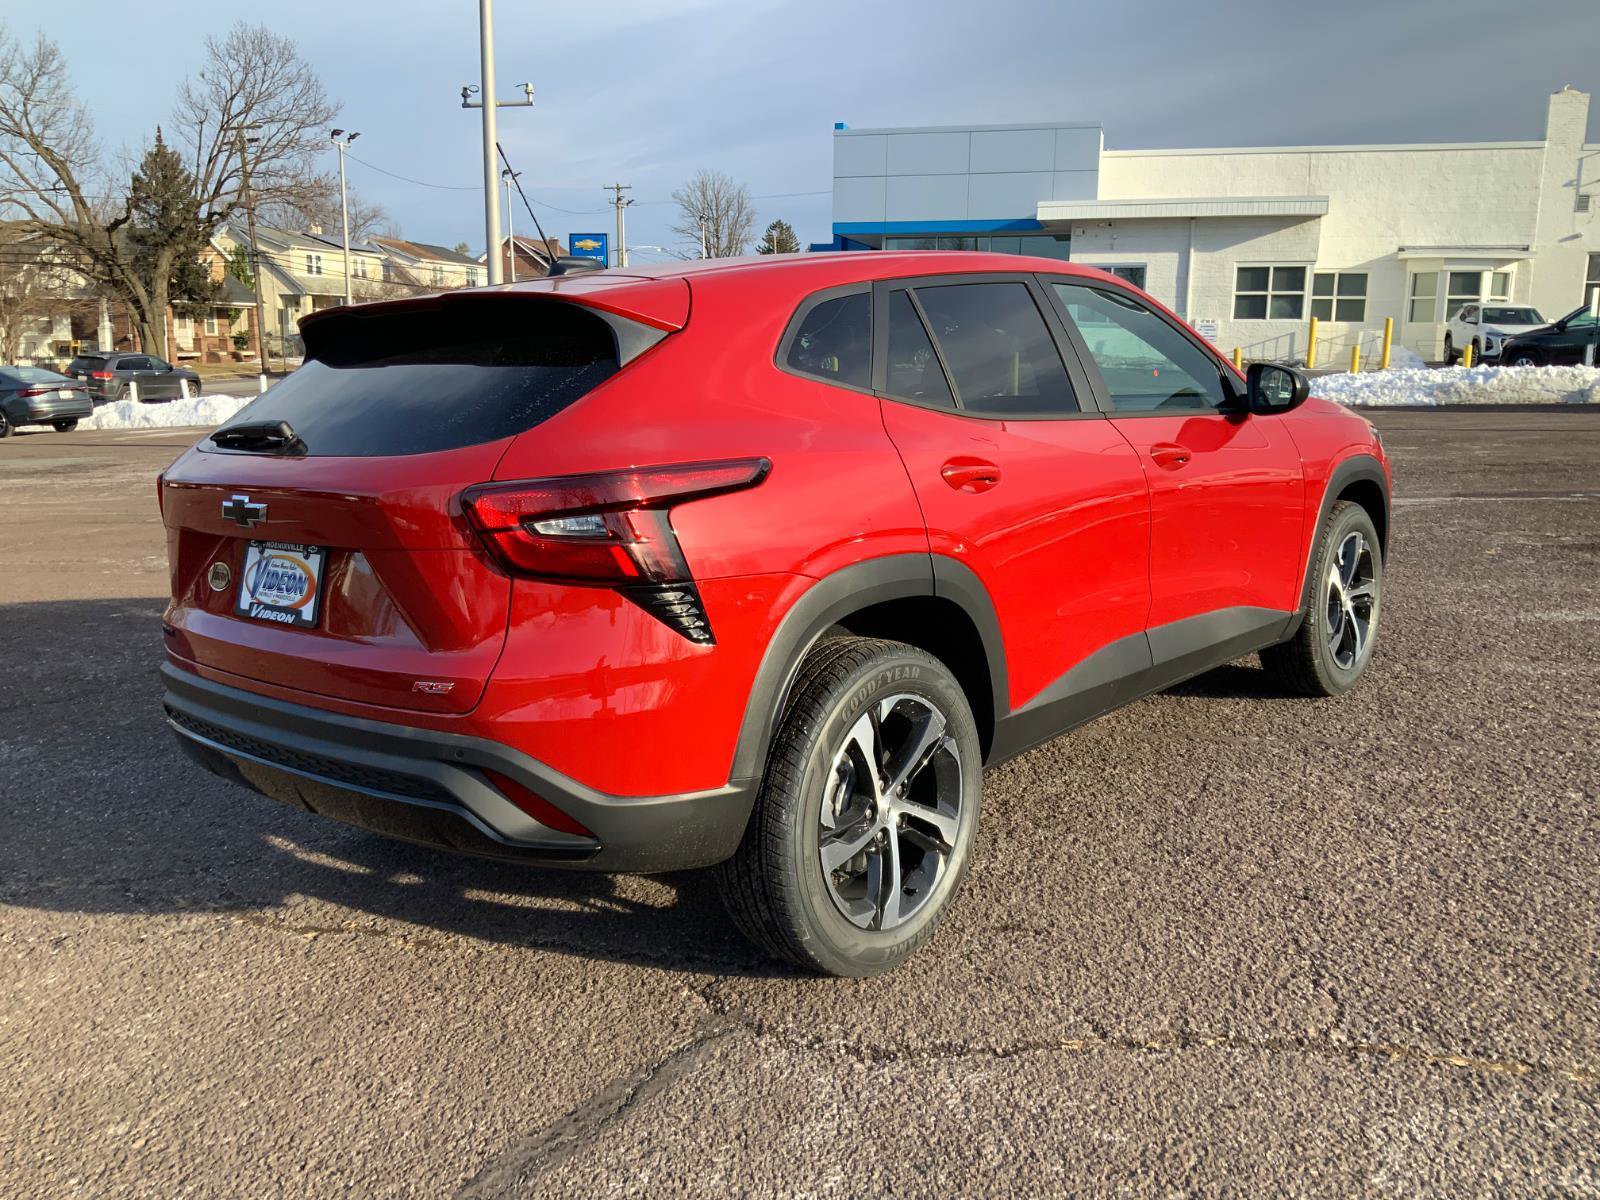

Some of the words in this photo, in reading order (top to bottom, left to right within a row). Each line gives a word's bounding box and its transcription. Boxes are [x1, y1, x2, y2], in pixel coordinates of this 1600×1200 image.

[262, 541, 305, 552] HOENIXVILLE
[250, 603, 296, 625] VIDEON
[411, 681, 455, 694] RS
[841, 666, 920, 722] GOODYEAR
